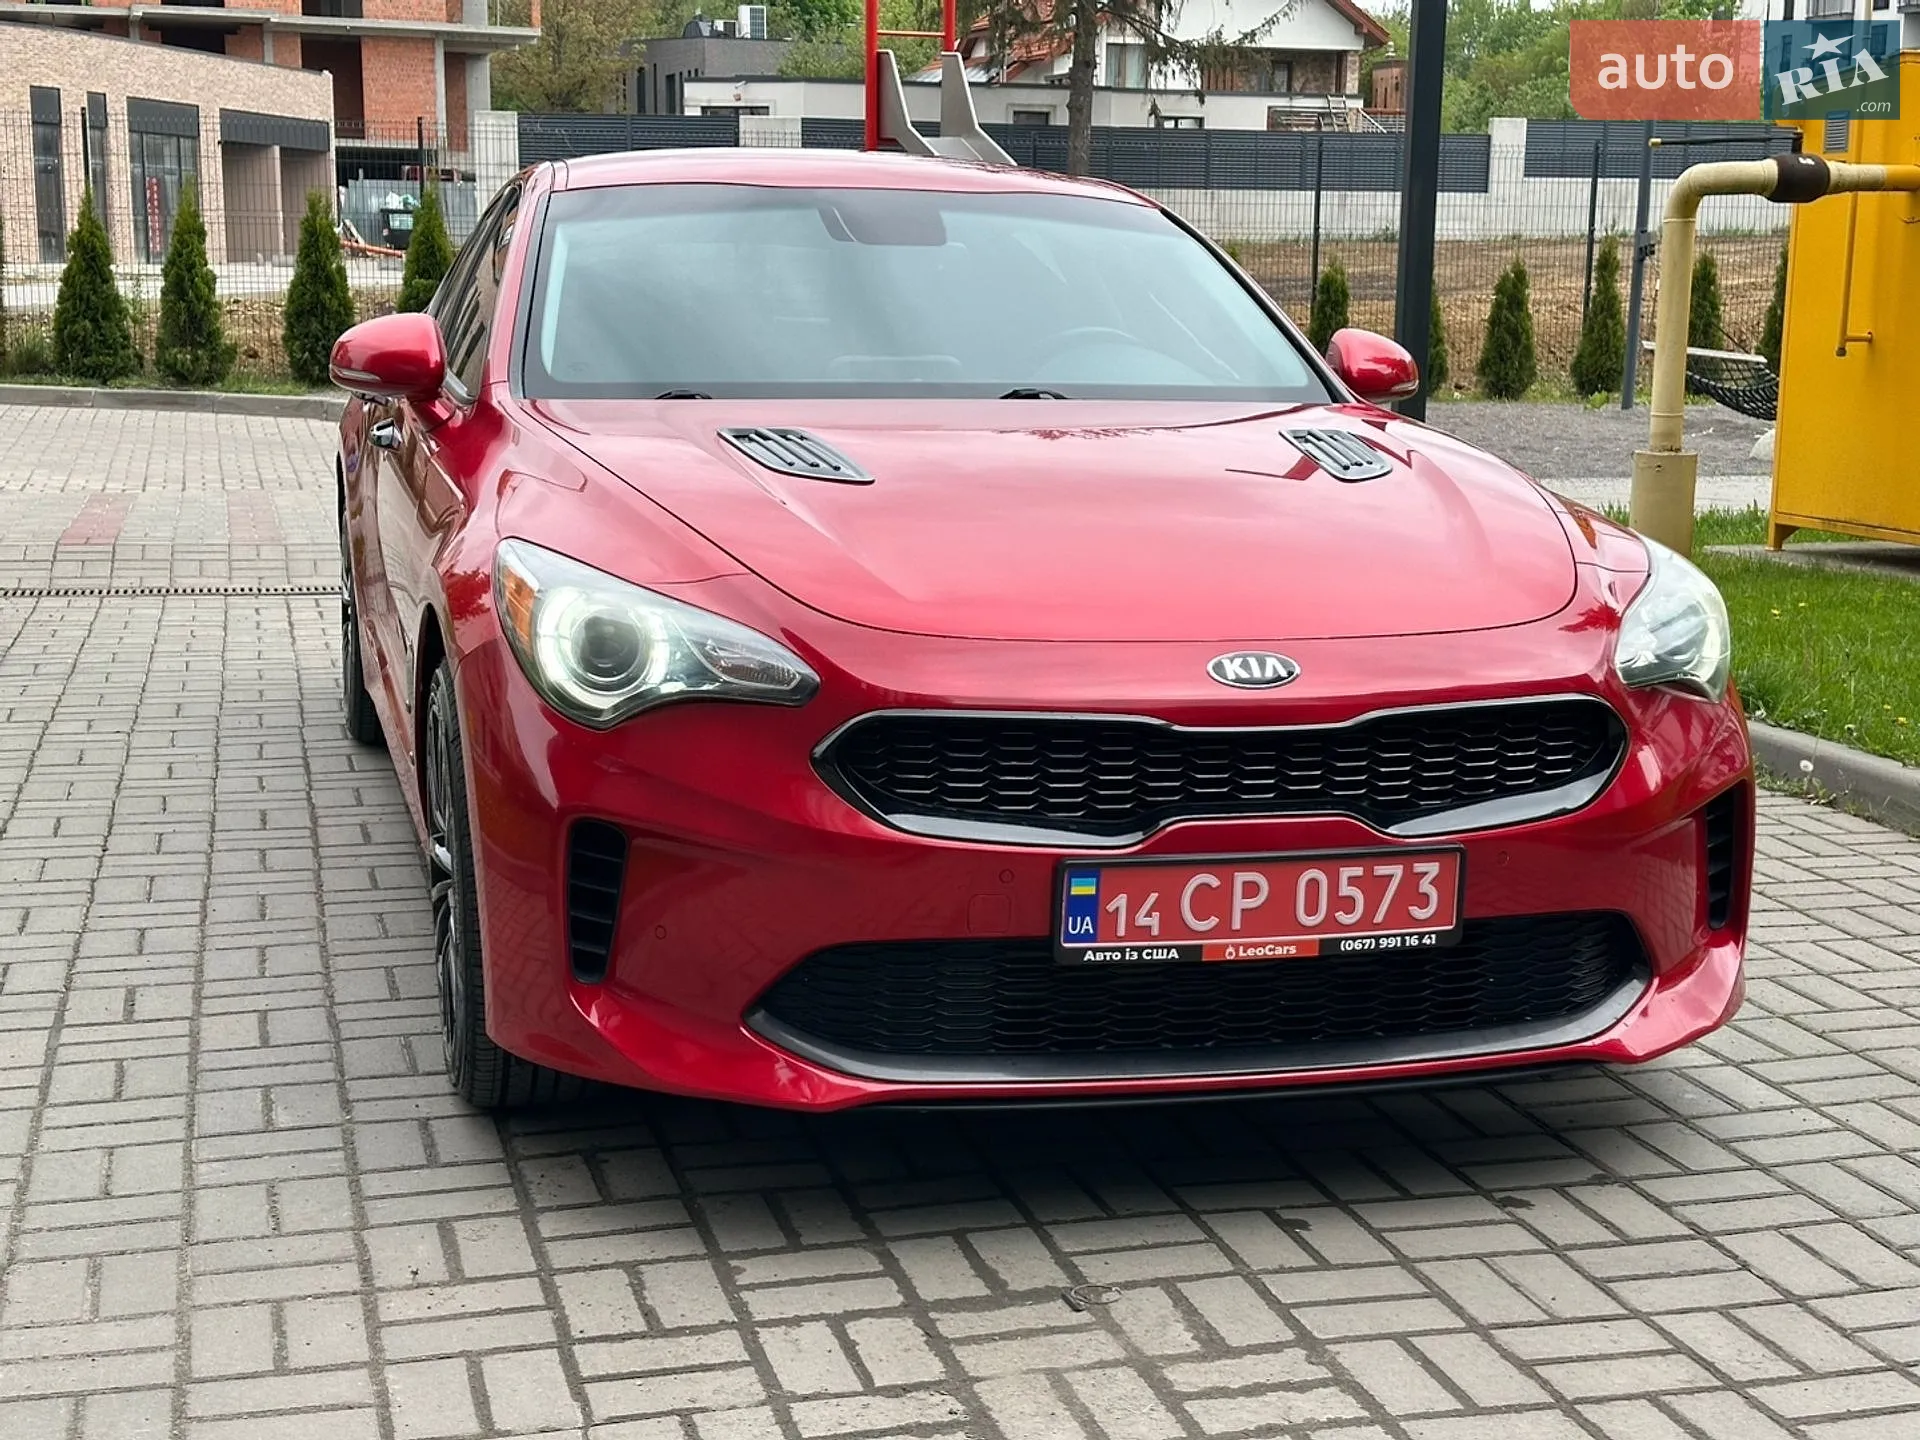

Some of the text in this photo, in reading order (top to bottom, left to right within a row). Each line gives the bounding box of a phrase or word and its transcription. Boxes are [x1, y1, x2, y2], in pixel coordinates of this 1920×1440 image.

[1220, 656, 1289, 680] KIA
[1105, 862, 1441, 937] 14 CP 0573
[1068, 915, 1094, 934] UA
[1238, 944, 1297, 957] LeoCars
[1340, 934, 1436, 951] (067) 991 16 41
[1083, 948, 1179, 961] Авто із США
